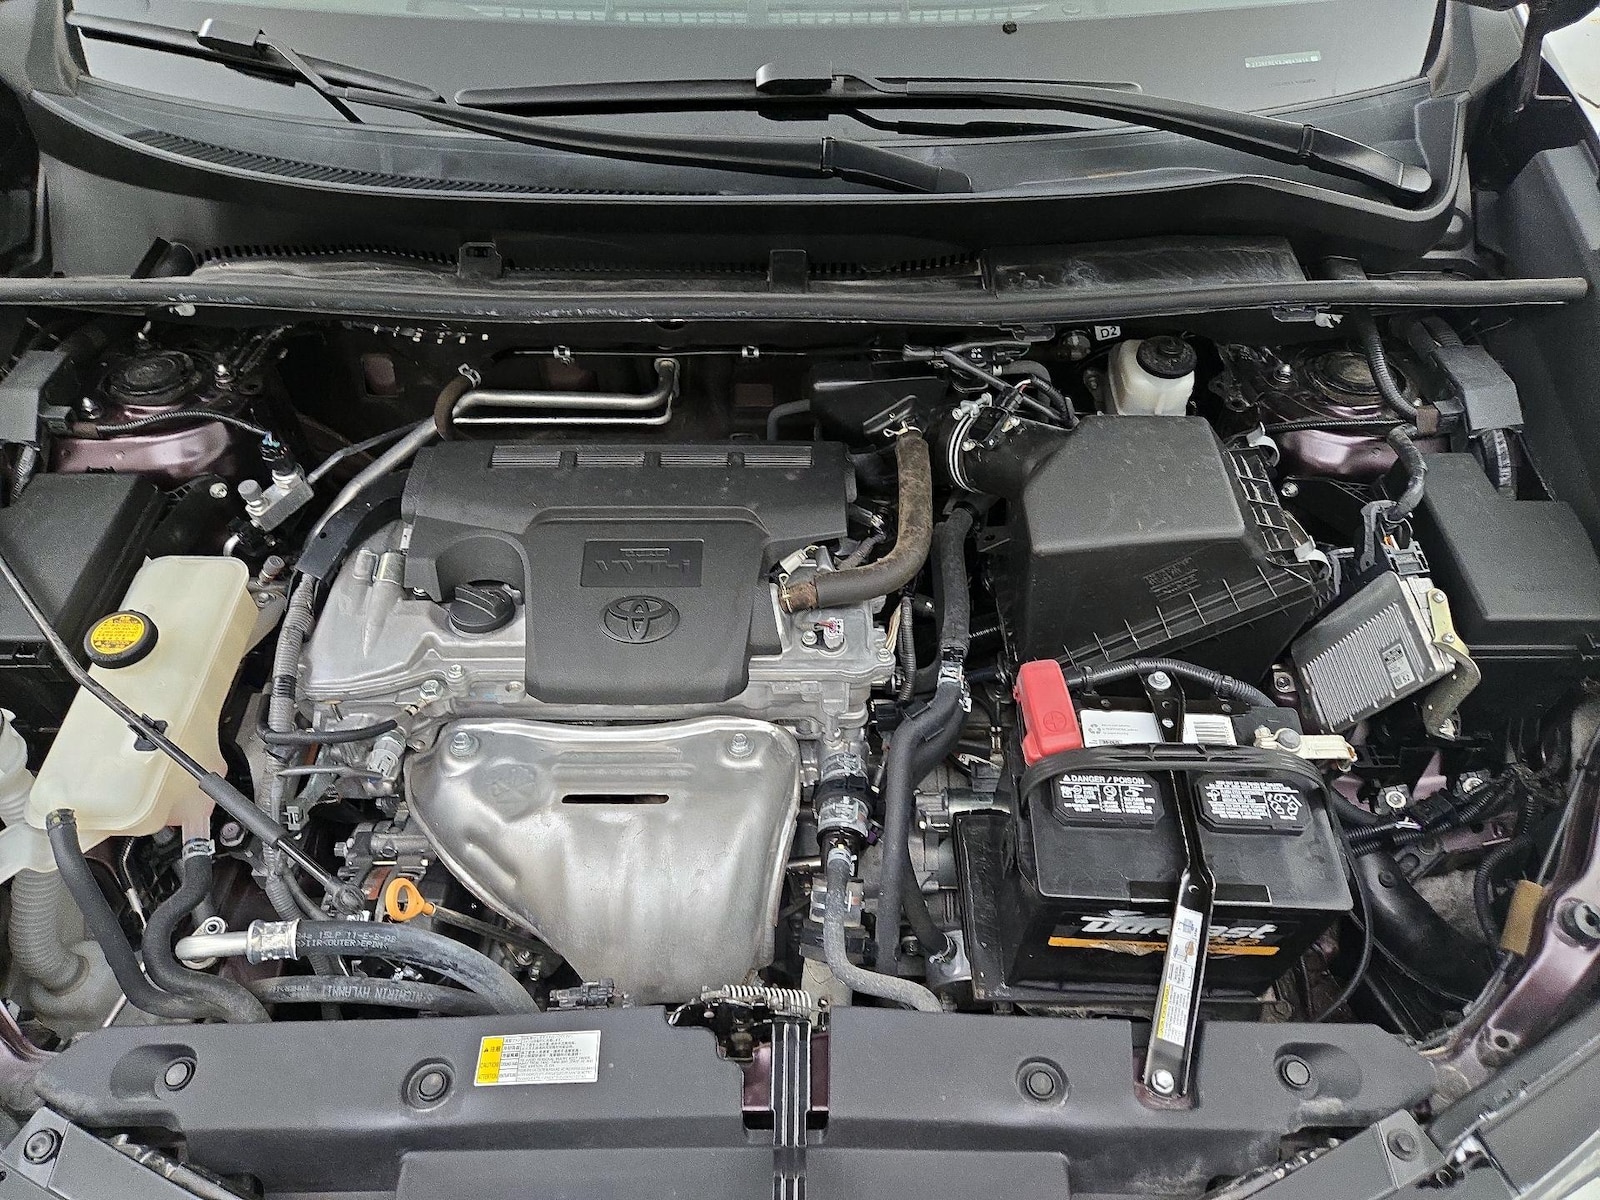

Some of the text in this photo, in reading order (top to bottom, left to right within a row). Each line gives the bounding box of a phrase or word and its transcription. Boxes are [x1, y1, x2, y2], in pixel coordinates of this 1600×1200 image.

[1101, 326, 1117, 338] D2
[1071, 775, 1106, 783] DANGER
[1113, 776, 1145, 785] POISON
